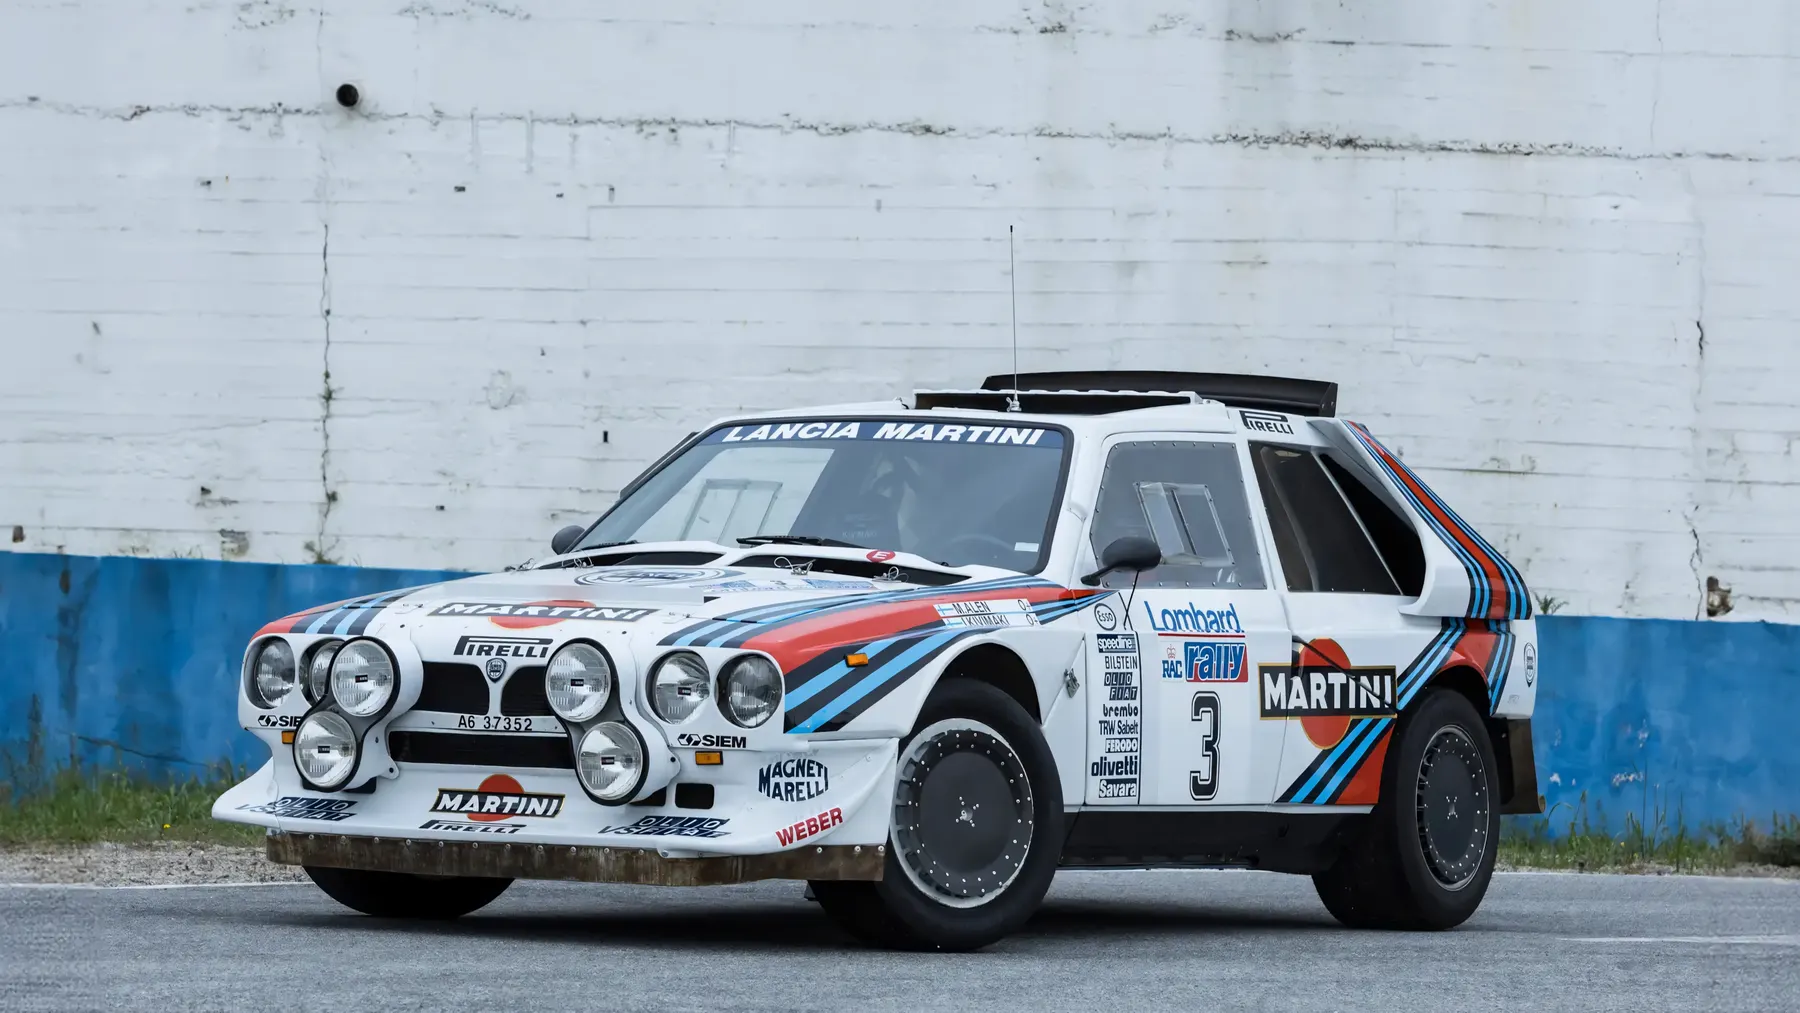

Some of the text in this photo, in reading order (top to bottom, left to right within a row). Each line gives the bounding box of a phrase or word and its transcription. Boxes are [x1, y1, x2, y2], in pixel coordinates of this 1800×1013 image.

[1239, 410, 1294, 435] PIRELLI
[722, 422, 1045, 445] LANCIA MARTINI
[872, 551, 890, 560] E
[438, 603, 647, 620] MARTINI
[454, 635, 554, 658] PIRELLI
[1098, 636, 1133, 652] speedline
[1105, 655, 1138, 670] BILSTEIN
[1162, 643, 1246, 681] RAC rally
[1104, 672, 1132, 686] OLIO
[1110, 686, 1137, 700] FIAT
[1263, 672, 1392, 710] MARTINI
[1103, 703, 1139, 717] brembo
[278, 715, 304, 727] SIE
[458, 715, 533, 731] A6 37352
[1099, 720, 1138, 735] TRW Sabelt
[701, 734, 747, 748] SIEM
[1105, 738, 1138, 752] FERODO
[1189, 690, 1222, 801] 3
[758, 758, 828, 780] MAGNETI
[1091, 756, 1138, 776] olivetti
[758, 779, 829, 802] MARELLI
[1099, 779, 1137, 797] Savara
[273, 797, 353, 811] OLIO
[436, 793, 559, 816] MARTINI
[418, 820, 527, 834] PIRELLI
[637, 817, 724, 830] OLIO
[775, 807, 843, 847] WEBER
